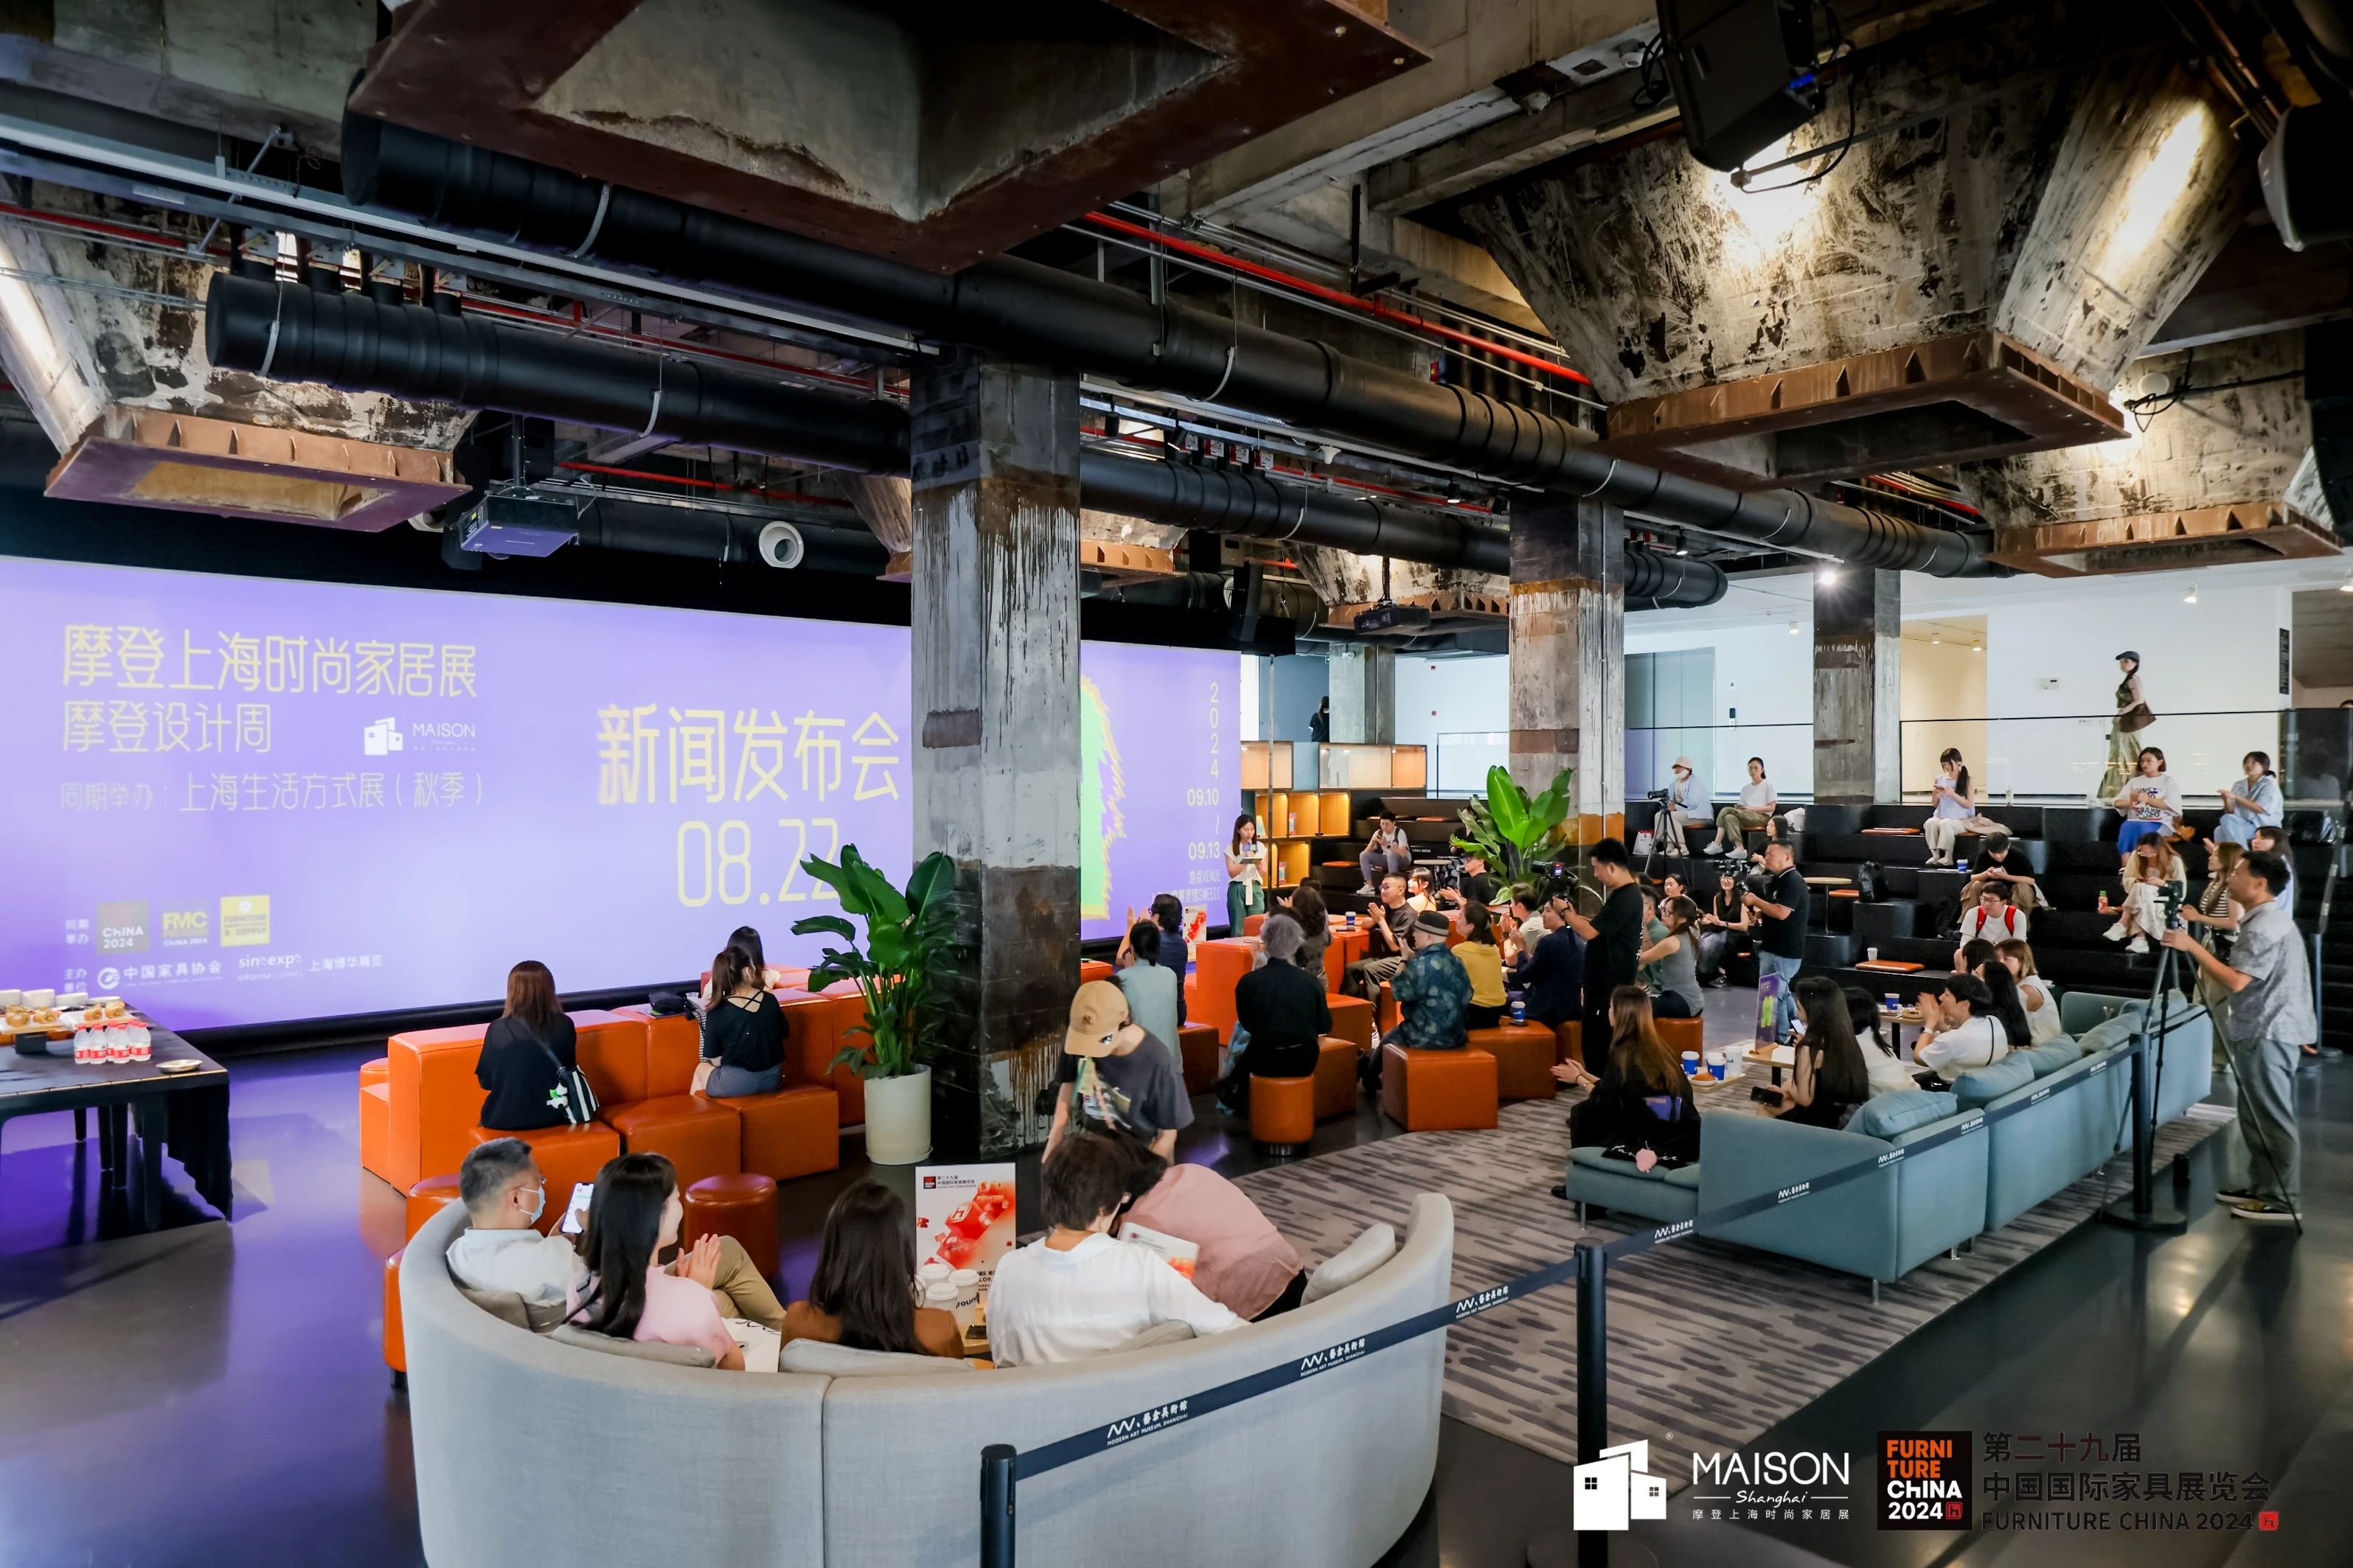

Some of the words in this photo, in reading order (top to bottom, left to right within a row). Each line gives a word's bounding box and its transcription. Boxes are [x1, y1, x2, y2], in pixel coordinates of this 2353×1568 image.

[63, 624, 478, 698] 摩登上海时尚家居展
[63, 700, 271, 753] 摩登设计周
[413, 722, 476, 738] MAISON
[597, 703, 900, 805] 新闻发布会
[1186, 788, 1220, 806] 09.10
[1188, 841, 1221, 861] 09.13
[677, 818, 839, 907] 08.22
[163, 911, 208, 930] FMC
[103, 938, 133, 949] 2024
[124, 960, 221, 980] 中国家具协会
[1107, 1434, 1129, 1446] MODERN
[1130, 1430, 1140, 1438] ART
[1163, 1412, 1188, 1426] SHANGHAI
